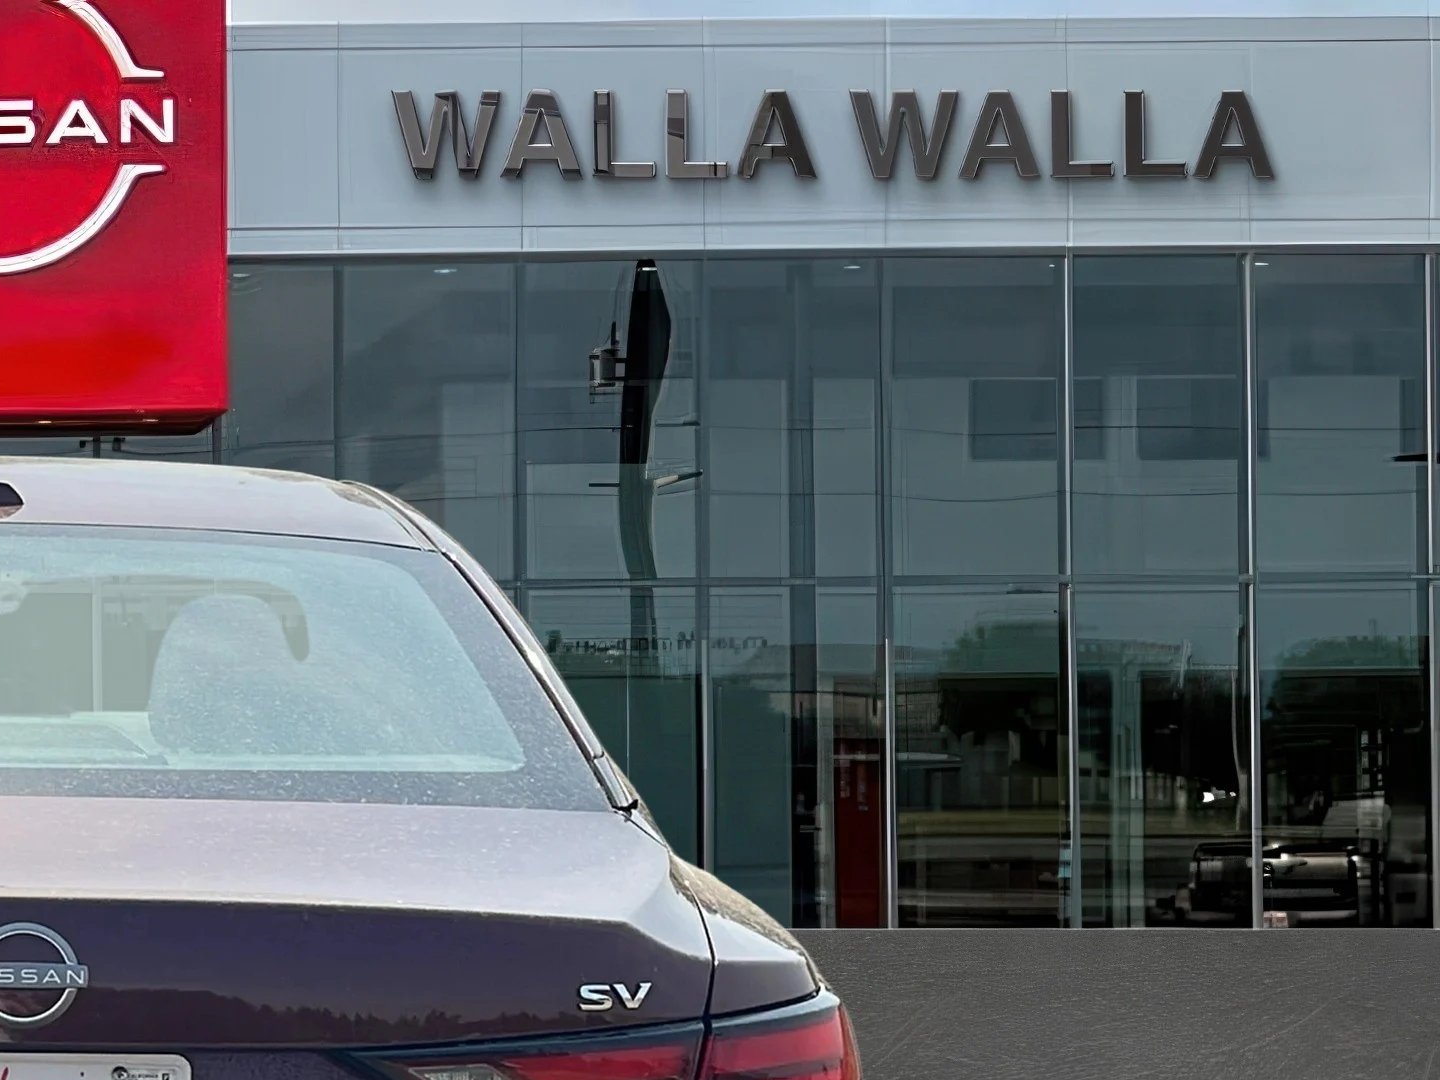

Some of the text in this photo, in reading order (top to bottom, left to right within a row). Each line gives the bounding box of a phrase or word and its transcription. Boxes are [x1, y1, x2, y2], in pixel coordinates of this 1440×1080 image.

[391, 89, 1276, 181] WALLA WALLA
[579, 982, 653, 1012] SV
